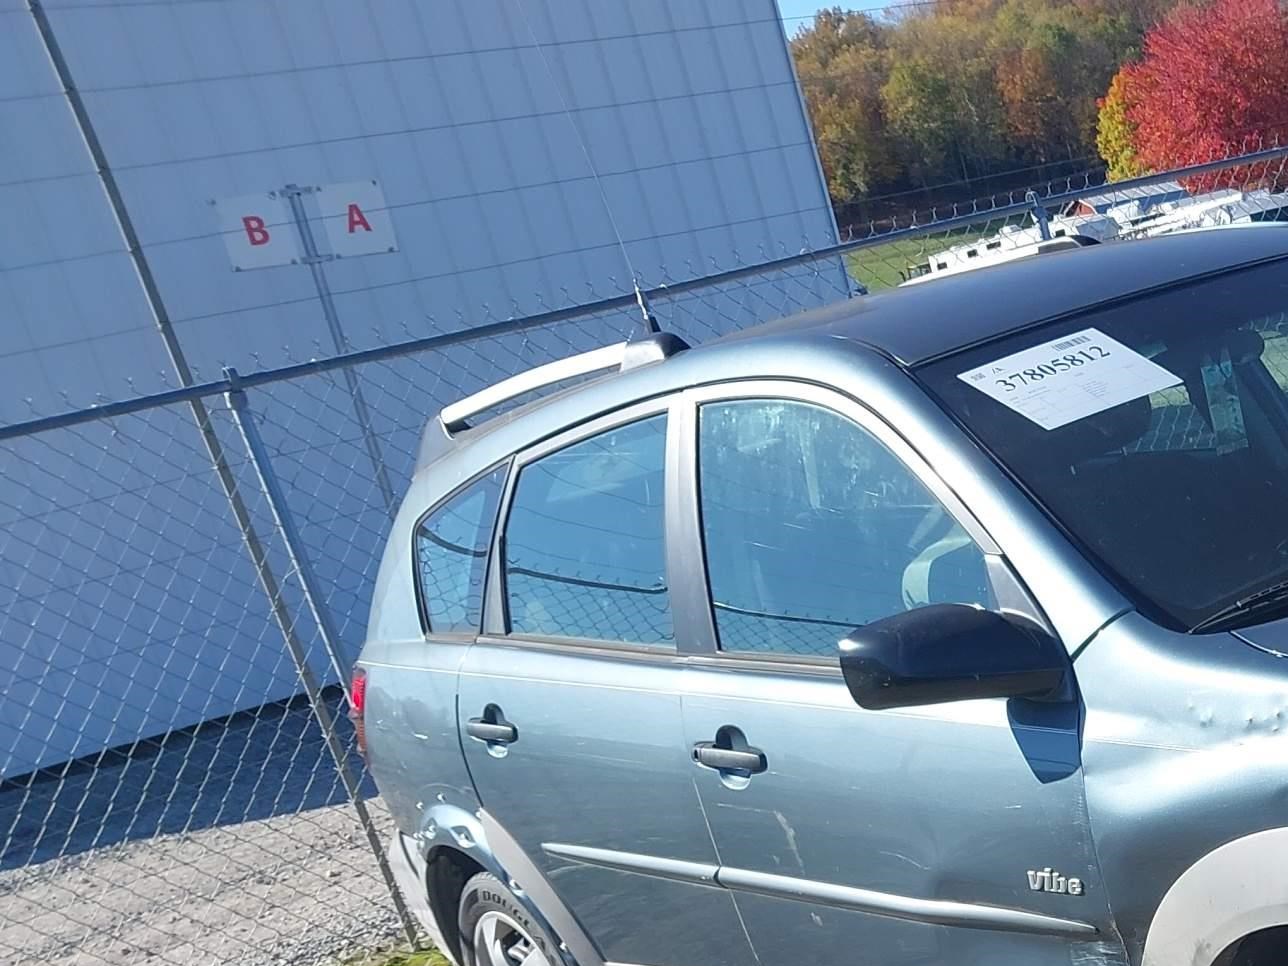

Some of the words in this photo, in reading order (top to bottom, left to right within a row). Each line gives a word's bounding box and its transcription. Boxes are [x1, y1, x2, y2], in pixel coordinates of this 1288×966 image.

[242, 216, 270, 245] B
[348, 204, 372, 233] A
[996, 346, 1111, 392] 37805812
